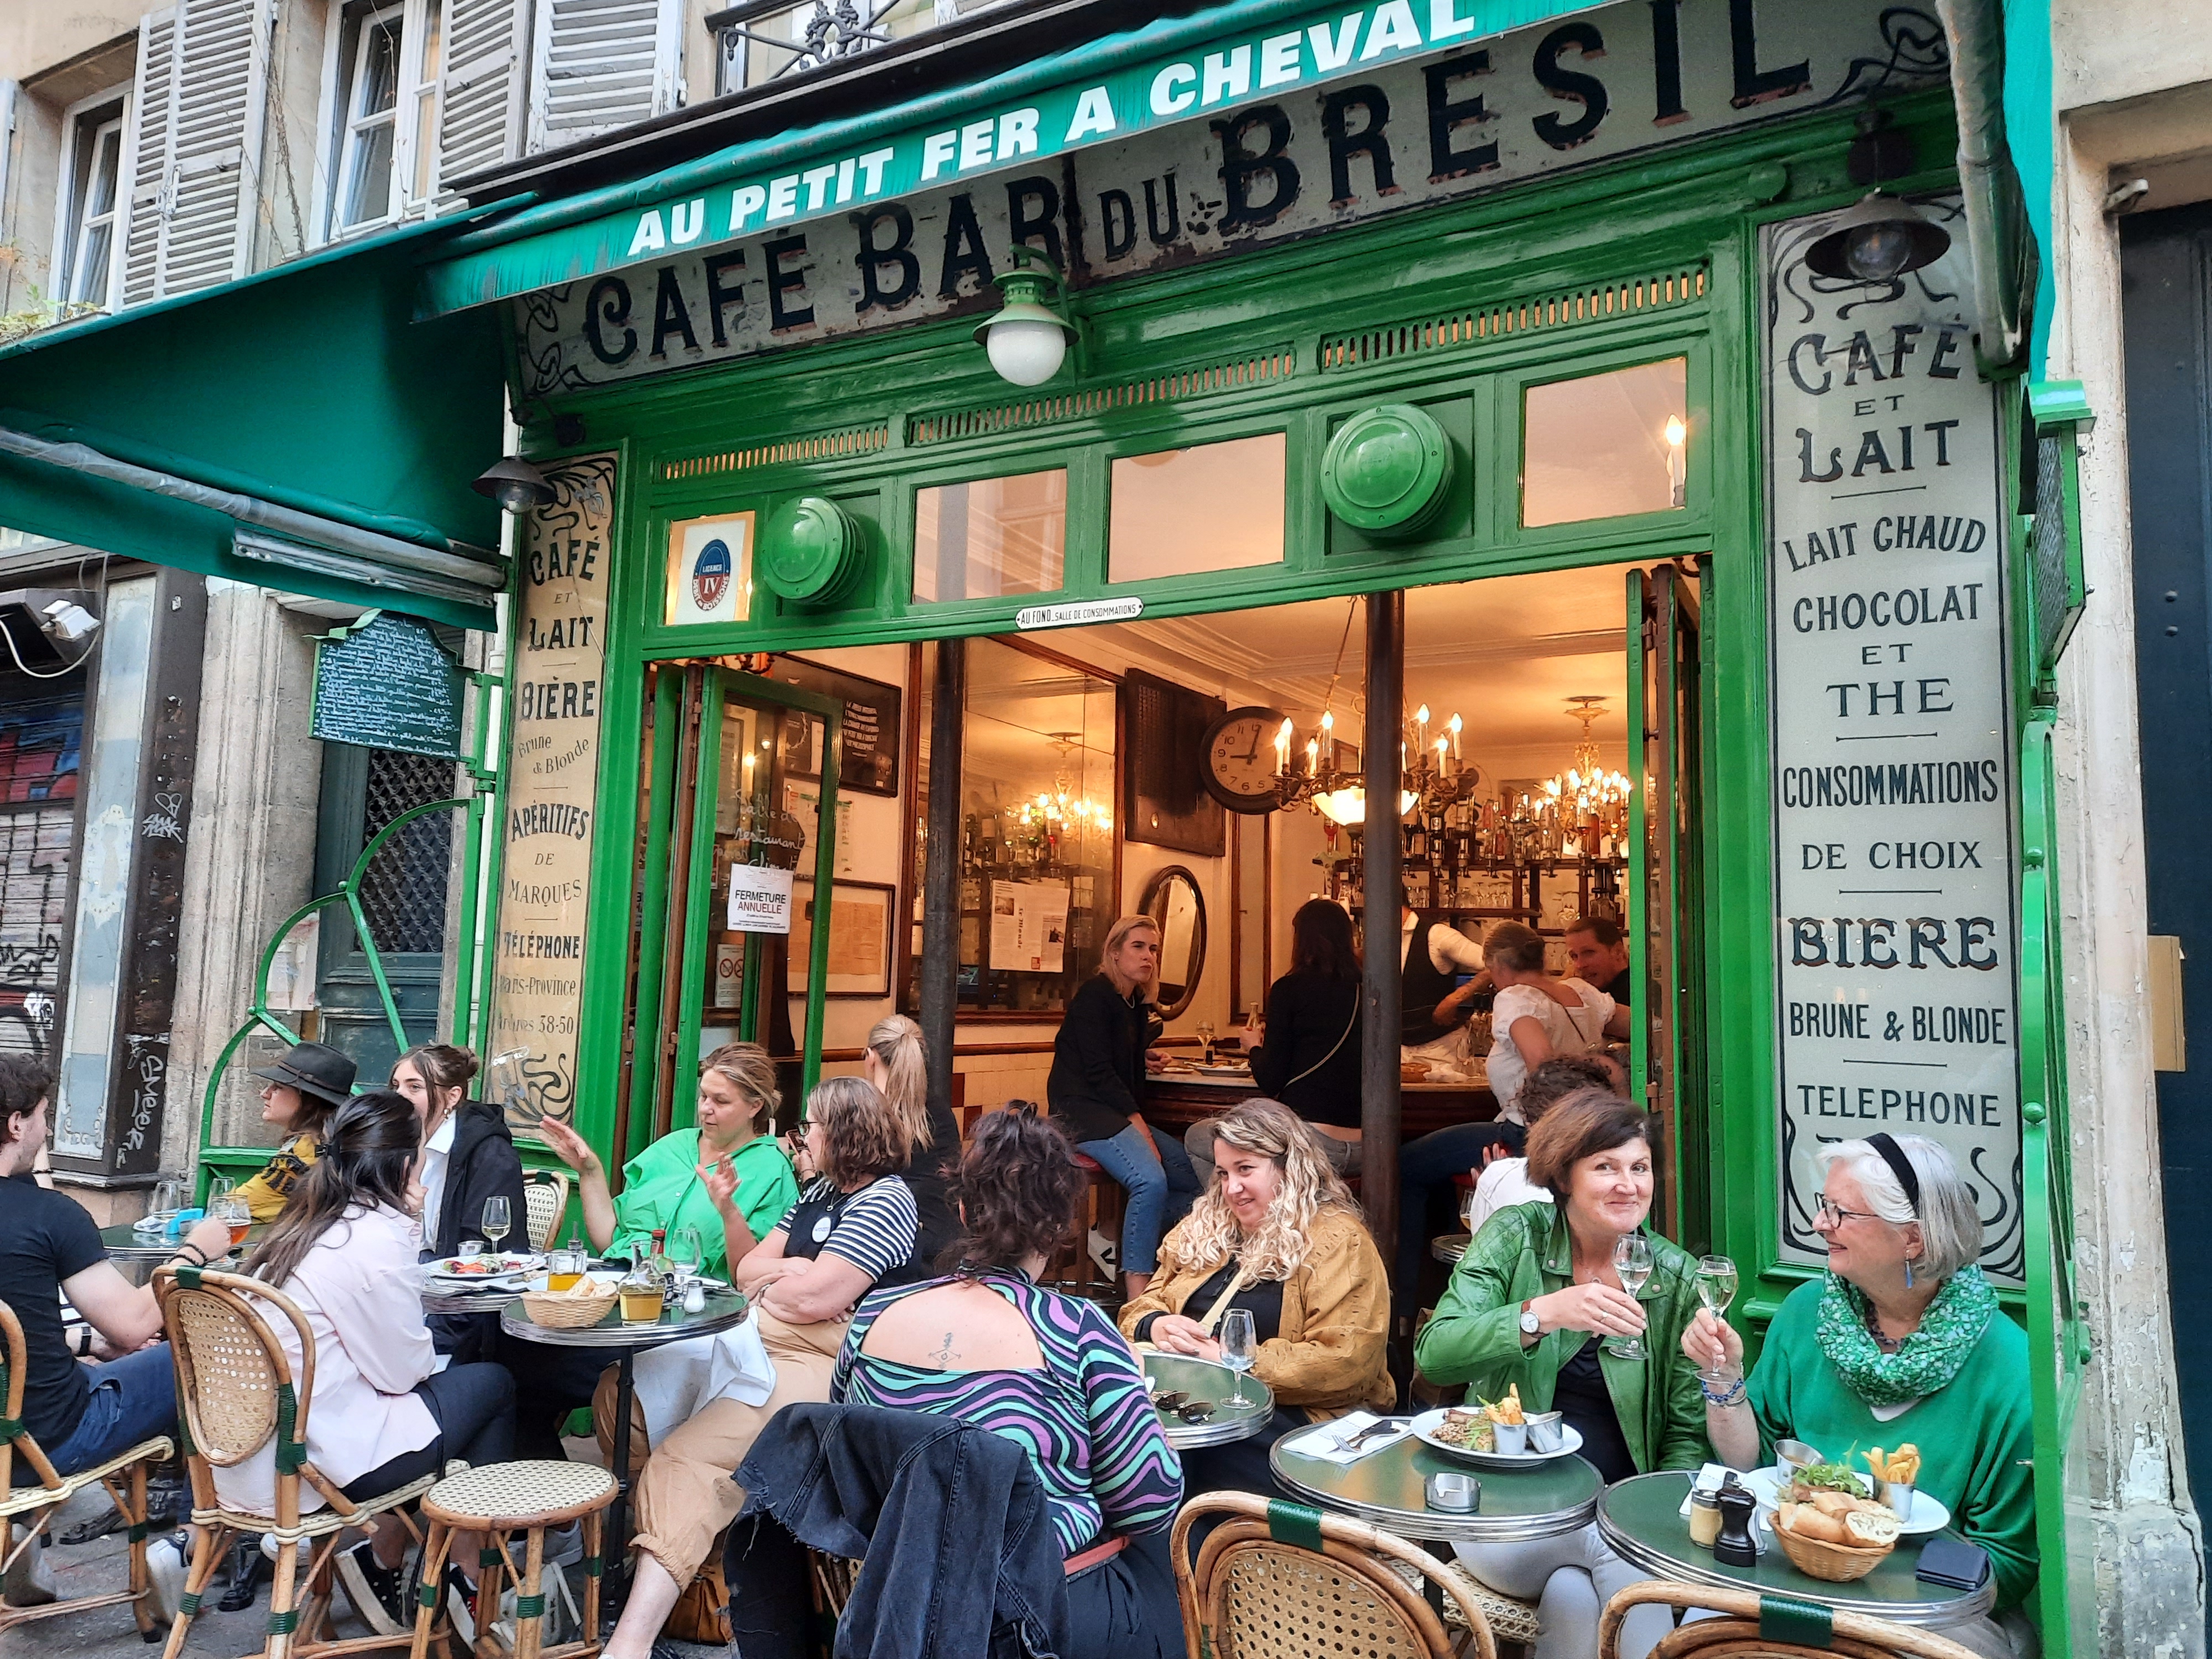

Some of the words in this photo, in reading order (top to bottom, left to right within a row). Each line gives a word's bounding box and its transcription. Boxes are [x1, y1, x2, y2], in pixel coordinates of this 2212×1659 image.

[627, 199, 706, 257] AU
[729, 147, 894, 231] PETIT
[920, 107, 1040, 181] FER
[1064, 85, 1116, 143] A
[1149, 0, 1475, 116] CHEVAL
[848, 176, 1065, 314] BAR
[1097, 173, 1182, 262] DU
[1853, 394, 1905, 416] ET
[1795, 419, 1960, 483] LAIT
[1782, 523, 1858, 572] LAIT
[1873, 515, 1986, 553] CHAUD
[554, 593, 573, 604] ET
[703, 577, 721, 594] IV
[1021, 612, 1030, 624] AU
[1055, 611, 1072, 620] SALLE
[1074, 609, 1081, 618] DE
[1083, 604, 1136, 618] CONSOMMATIONS
[1793, 583, 1983, 633] CHOCOLAT
[528, 616, 593, 651] LAIT
[1861, 643, 1913, 665] ET
[1825, 678, 1954, 717] THE
[1224, 736, 1235, 744] 10
[1237, 724, 1244, 734] 11
[533, 762, 542, 774] &
[545, 738, 589, 774] Blonde
[1230, 776, 1237, 785] 7
[1783, 760, 1998, 808] CONSOMMATIONS
[510, 799, 590, 843] APÉRITIFS
[534, 853, 554, 865] DE
[1802, 844, 1847, 870] DE
[1869, 841, 1983, 869] CHOIX
[507, 879, 582, 907] MARQUES
[735, 890, 786, 904] FERMETURE
[737, 901, 782, 914] ANNUELLE
[1787, 917, 1999, 971] BIERE
[1790, 1002, 1870, 1039] BRUNE
[1884, 1010, 1904, 1042] &
[1912, 1006, 2007, 1044] BLONDE
[1797, 1084, 2001, 1127] TELEPHONE
